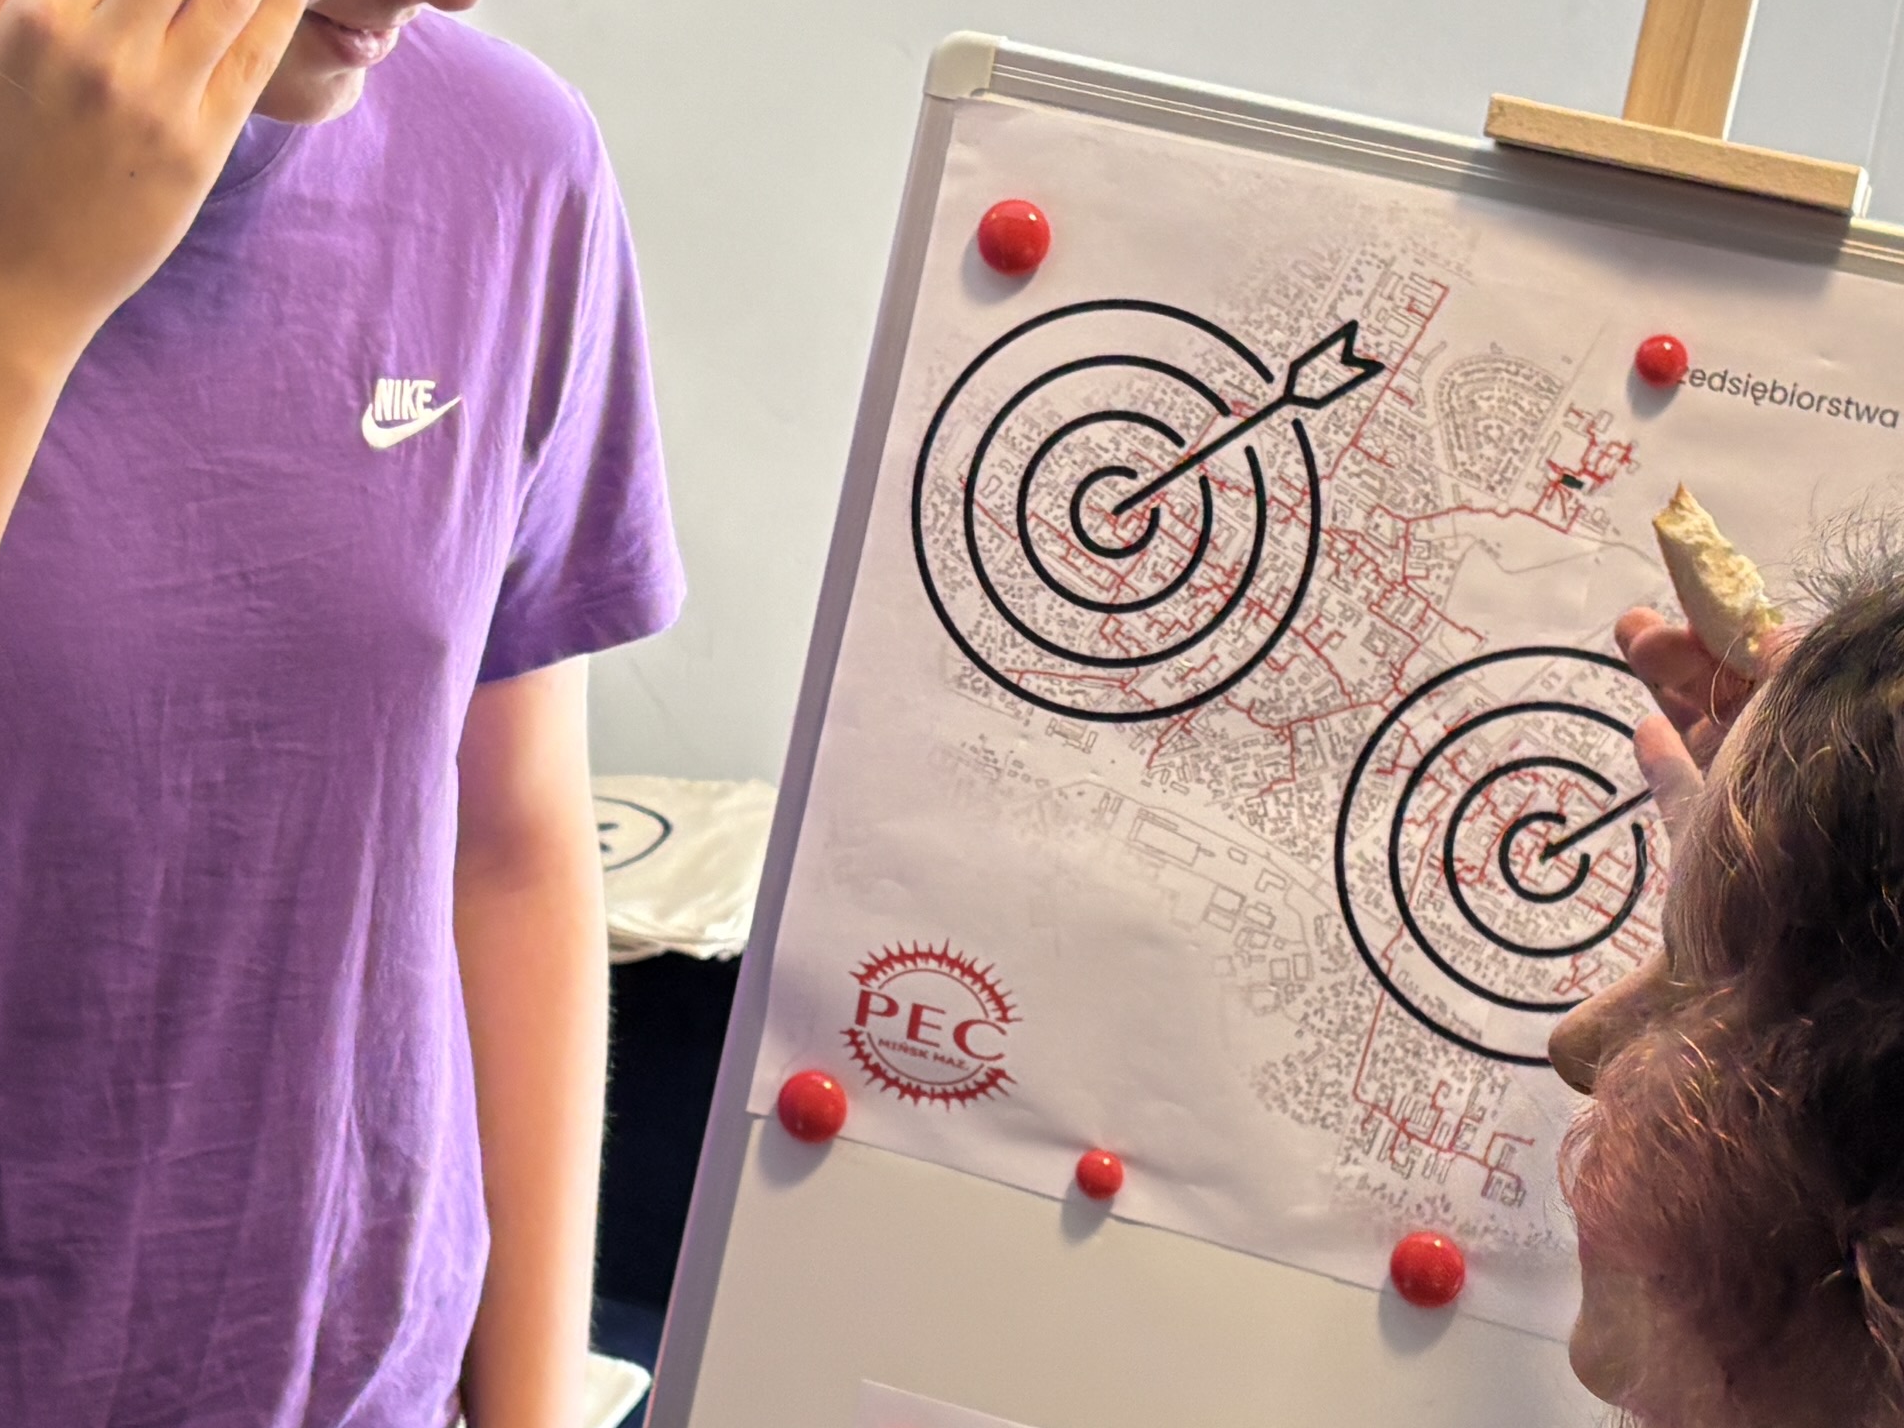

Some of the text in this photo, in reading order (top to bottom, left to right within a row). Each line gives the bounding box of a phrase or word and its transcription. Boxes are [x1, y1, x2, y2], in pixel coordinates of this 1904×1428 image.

[373, 378, 437, 422] NIKE
[1678, 365, 1900, 430] edsiębiorstwa
[854, 988, 1008, 1062] PEC
